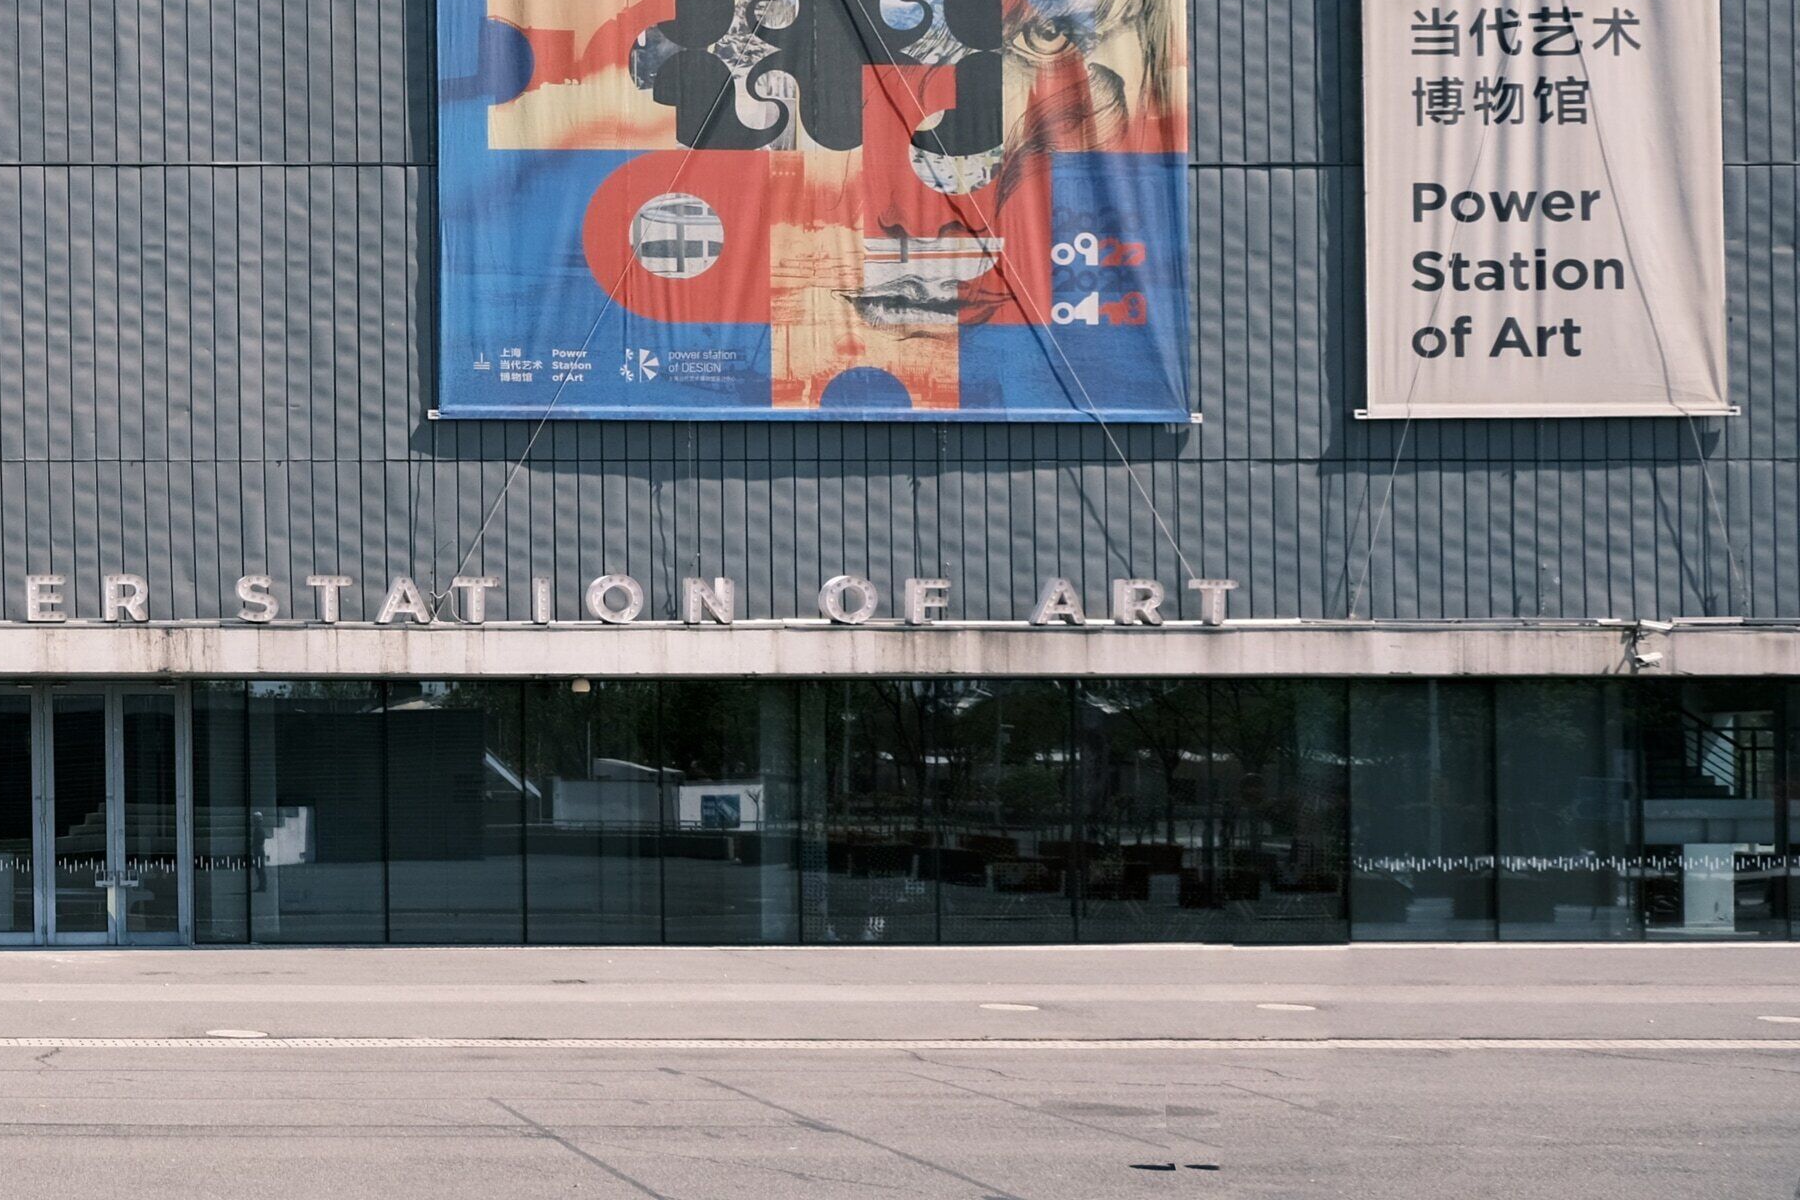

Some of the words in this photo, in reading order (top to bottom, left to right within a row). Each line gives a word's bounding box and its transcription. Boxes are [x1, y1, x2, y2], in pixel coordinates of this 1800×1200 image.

[1409, 7, 1643, 57] 当代艺术
[1411, 76, 1590, 127] 博物馆
[1411, 182, 1602, 224] Power
[1411, 248, 1625, 292] Station
[1411, 316, 1472, 360] of
[1488, 316, 1583, 359] Art
[500, 347, 521, 358] 上海
[552, 349, 588, 358] Power
[552, 361, 592, 370] Station
[668, 351, 700, 362] power
[702, 350, 737, 360] station
[552, 373, 565, 382] of
[565, 373, 584, 382] Art
[668, 363, 679, 373] of
[681, 363, 722, 373] DESIGN
[235, 573, 736, 625] STATION
[818, 575, 952, 625] OF
[1028, 576, 1240, 626] ART
